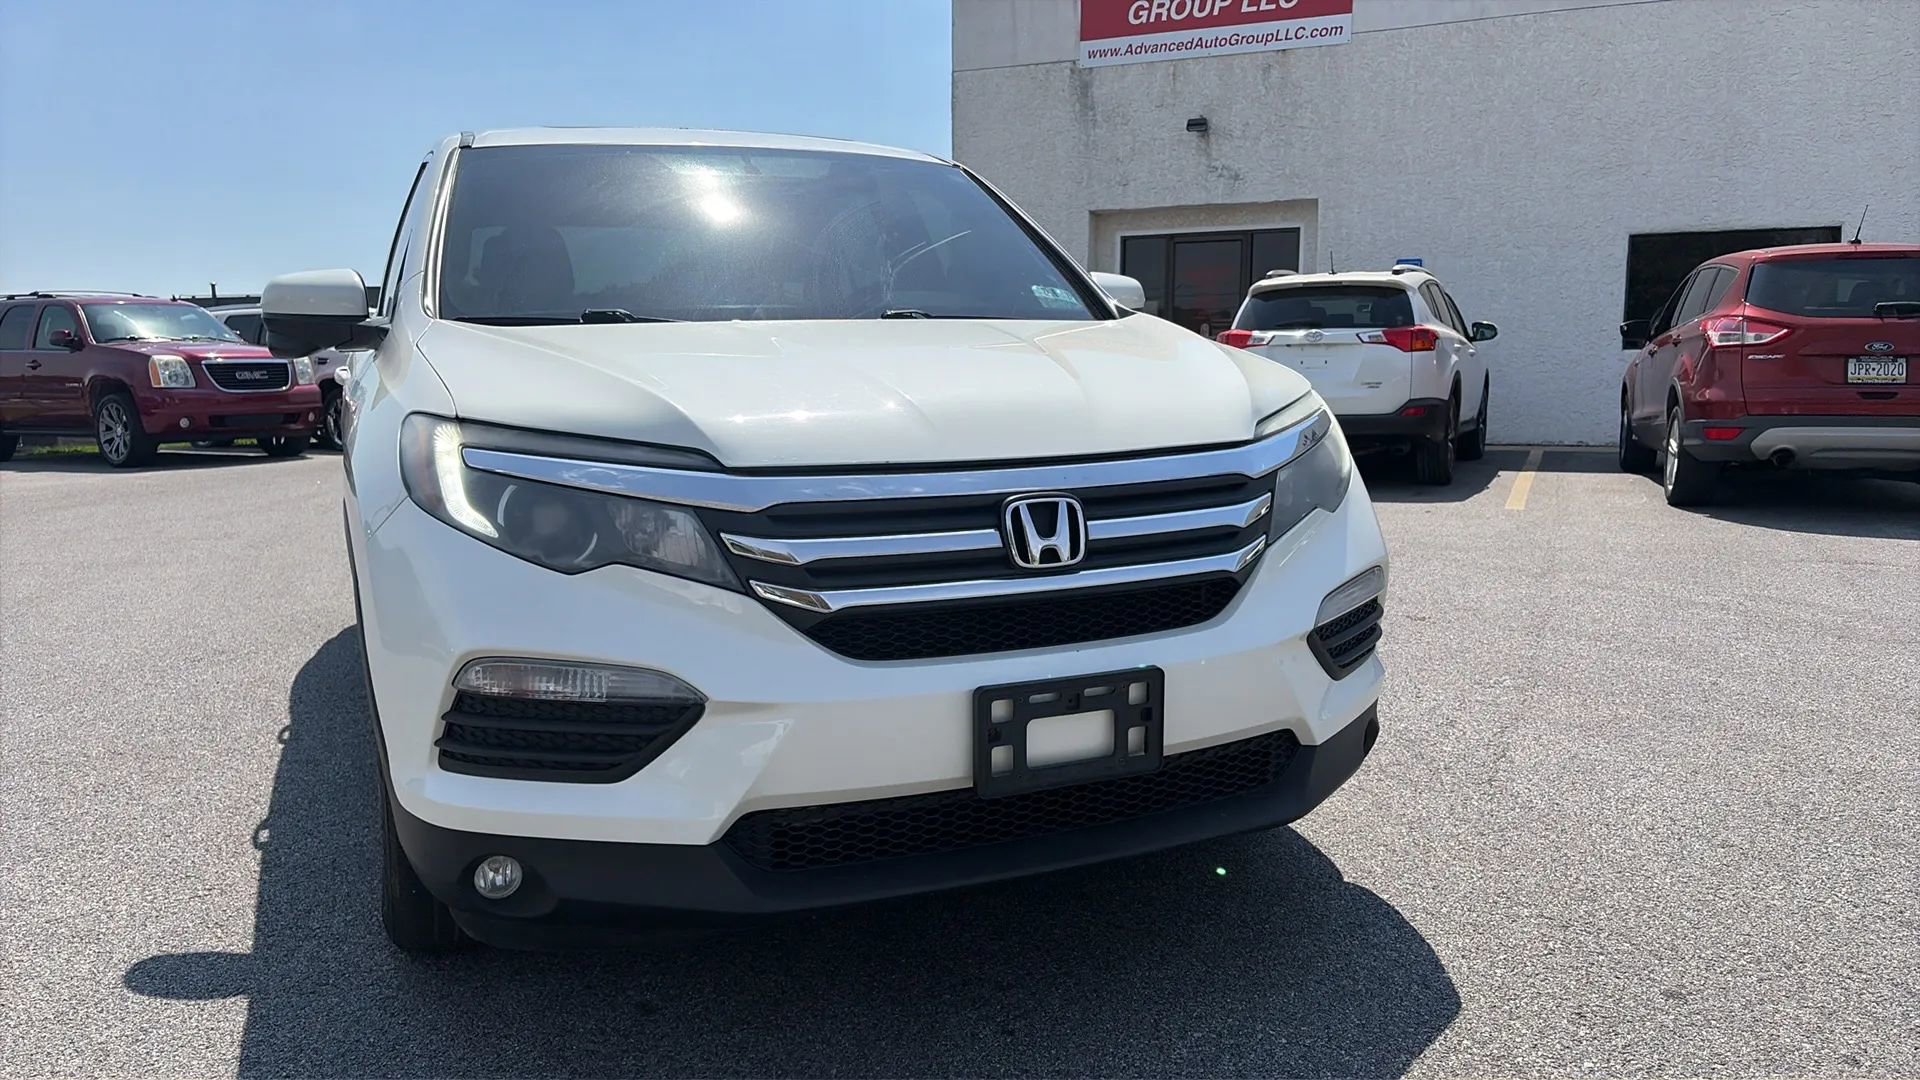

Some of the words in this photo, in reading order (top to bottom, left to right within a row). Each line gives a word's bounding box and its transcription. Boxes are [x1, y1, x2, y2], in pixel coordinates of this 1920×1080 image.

[1128, 0, 1232, 25] GROUP
[1087, 24, 1344, 60] www.AdvancedAutoGroupLLC.com
[235, 370, 269, 380] GMC
